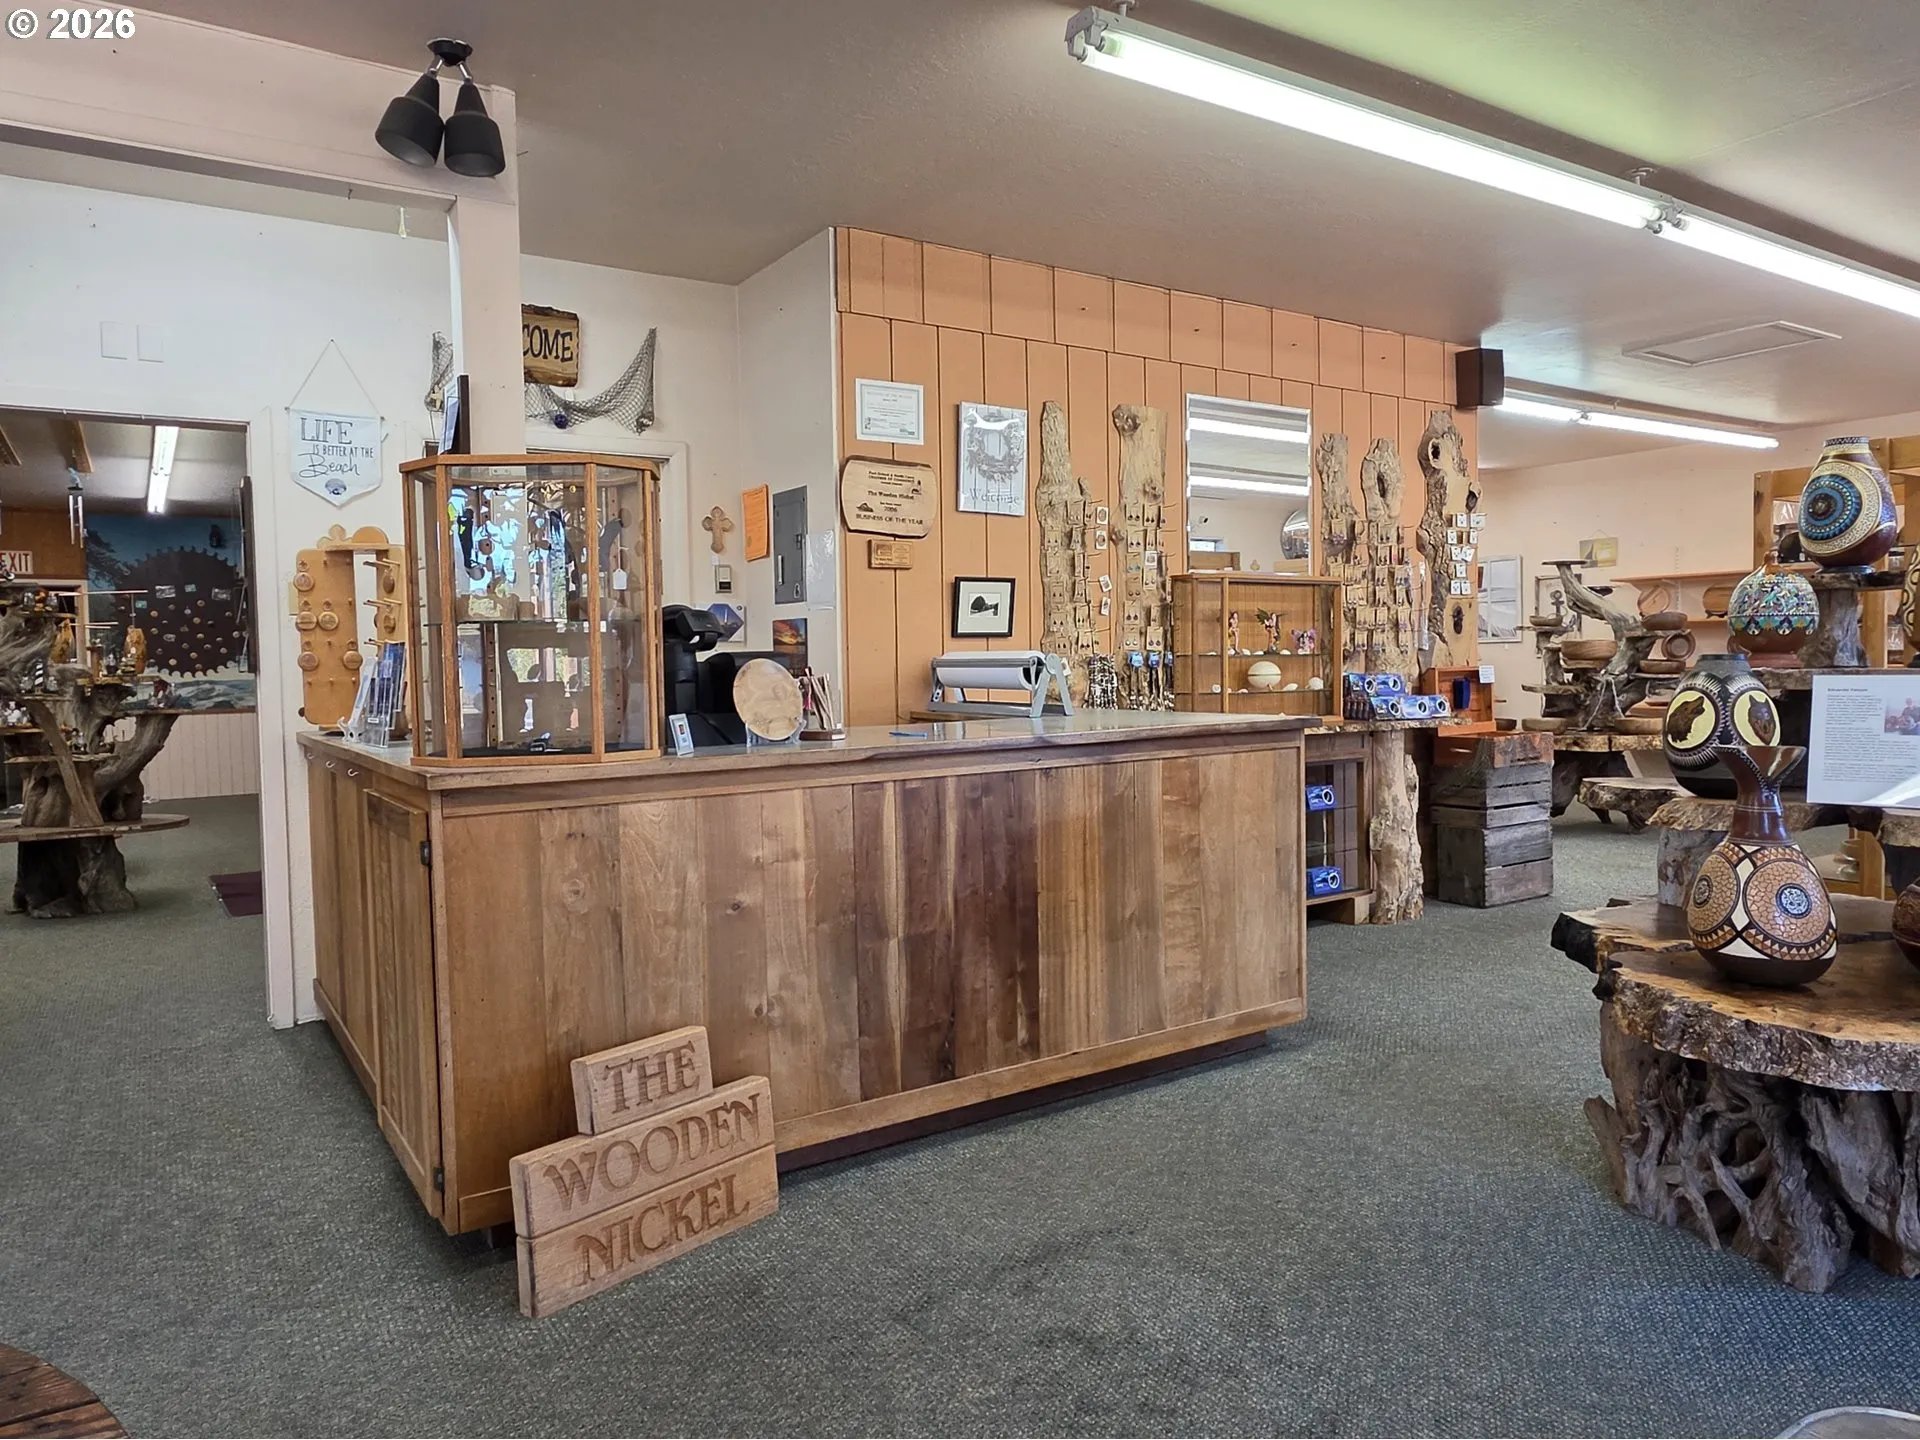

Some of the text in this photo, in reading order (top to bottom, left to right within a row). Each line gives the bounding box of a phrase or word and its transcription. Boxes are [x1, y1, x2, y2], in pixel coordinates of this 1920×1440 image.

[300, 417, 353, 445] LIFE
[298, 452, 361, 478] Beach
[313, 444, 374, 459] IS BETTER AT THE
[0, 552, 30, 572] EXIT
[603, 1040, 699, 1114] THE
[543, 1093, 760, 1212] WOODEN
[574, 1174, 750, 1287] NICKEL
